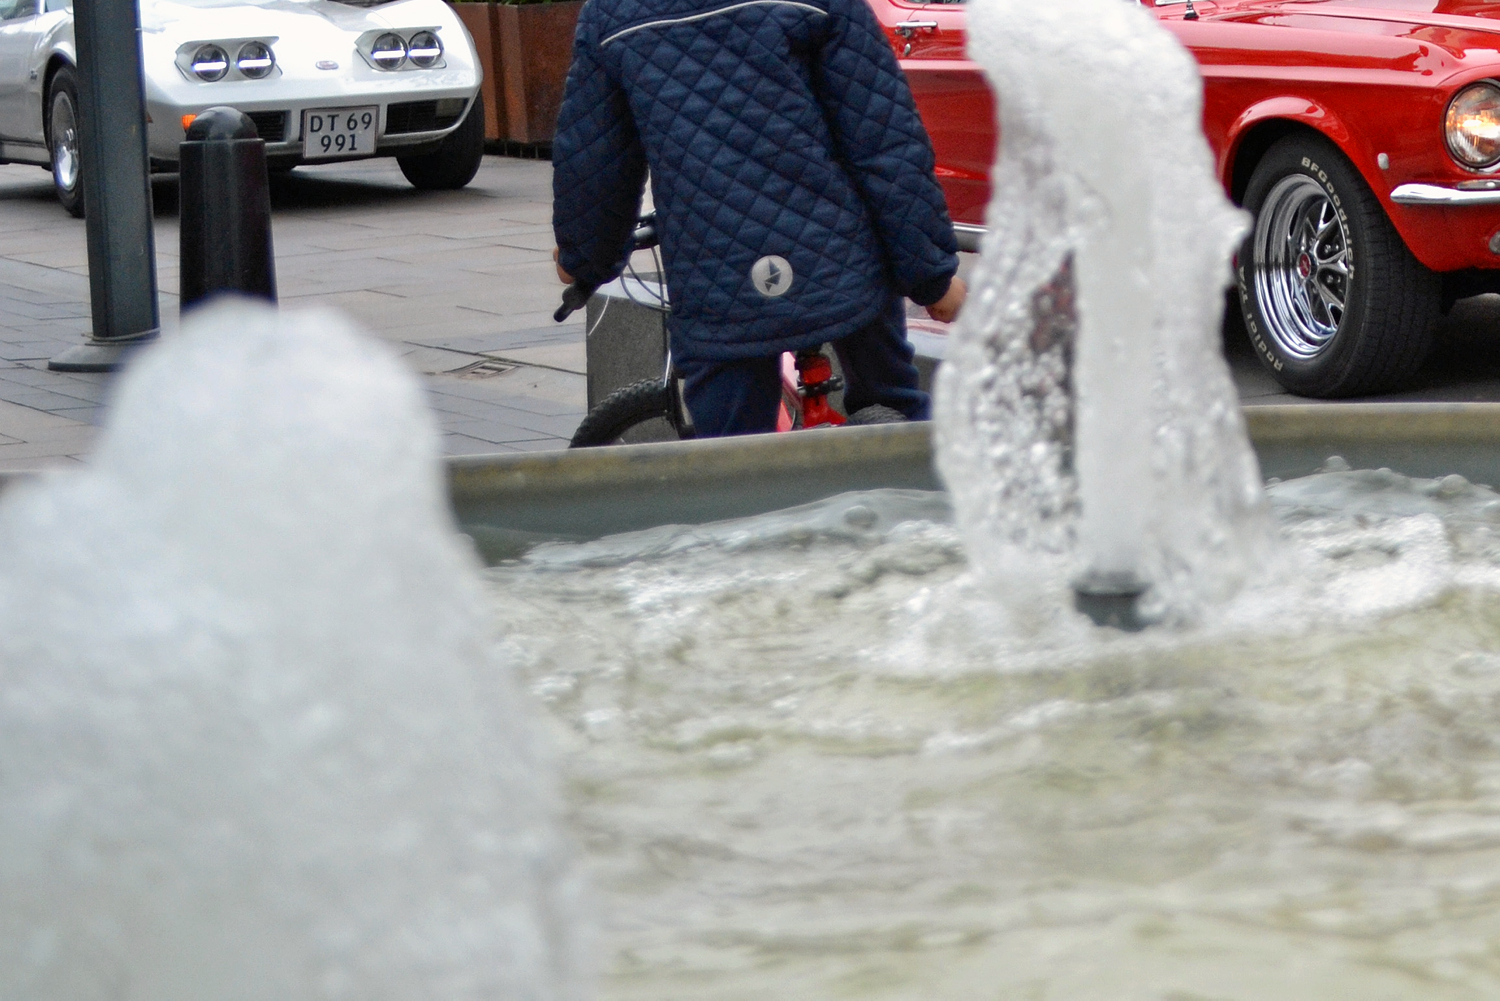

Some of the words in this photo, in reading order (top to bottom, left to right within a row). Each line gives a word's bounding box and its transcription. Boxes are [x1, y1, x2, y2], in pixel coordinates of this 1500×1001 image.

[310, 114, 339, 132] DT
[347, 112, 372, 131] 69
[320, 133, 357, 153] 991
[1301, 156, 1354, 280] BFGoodrich
